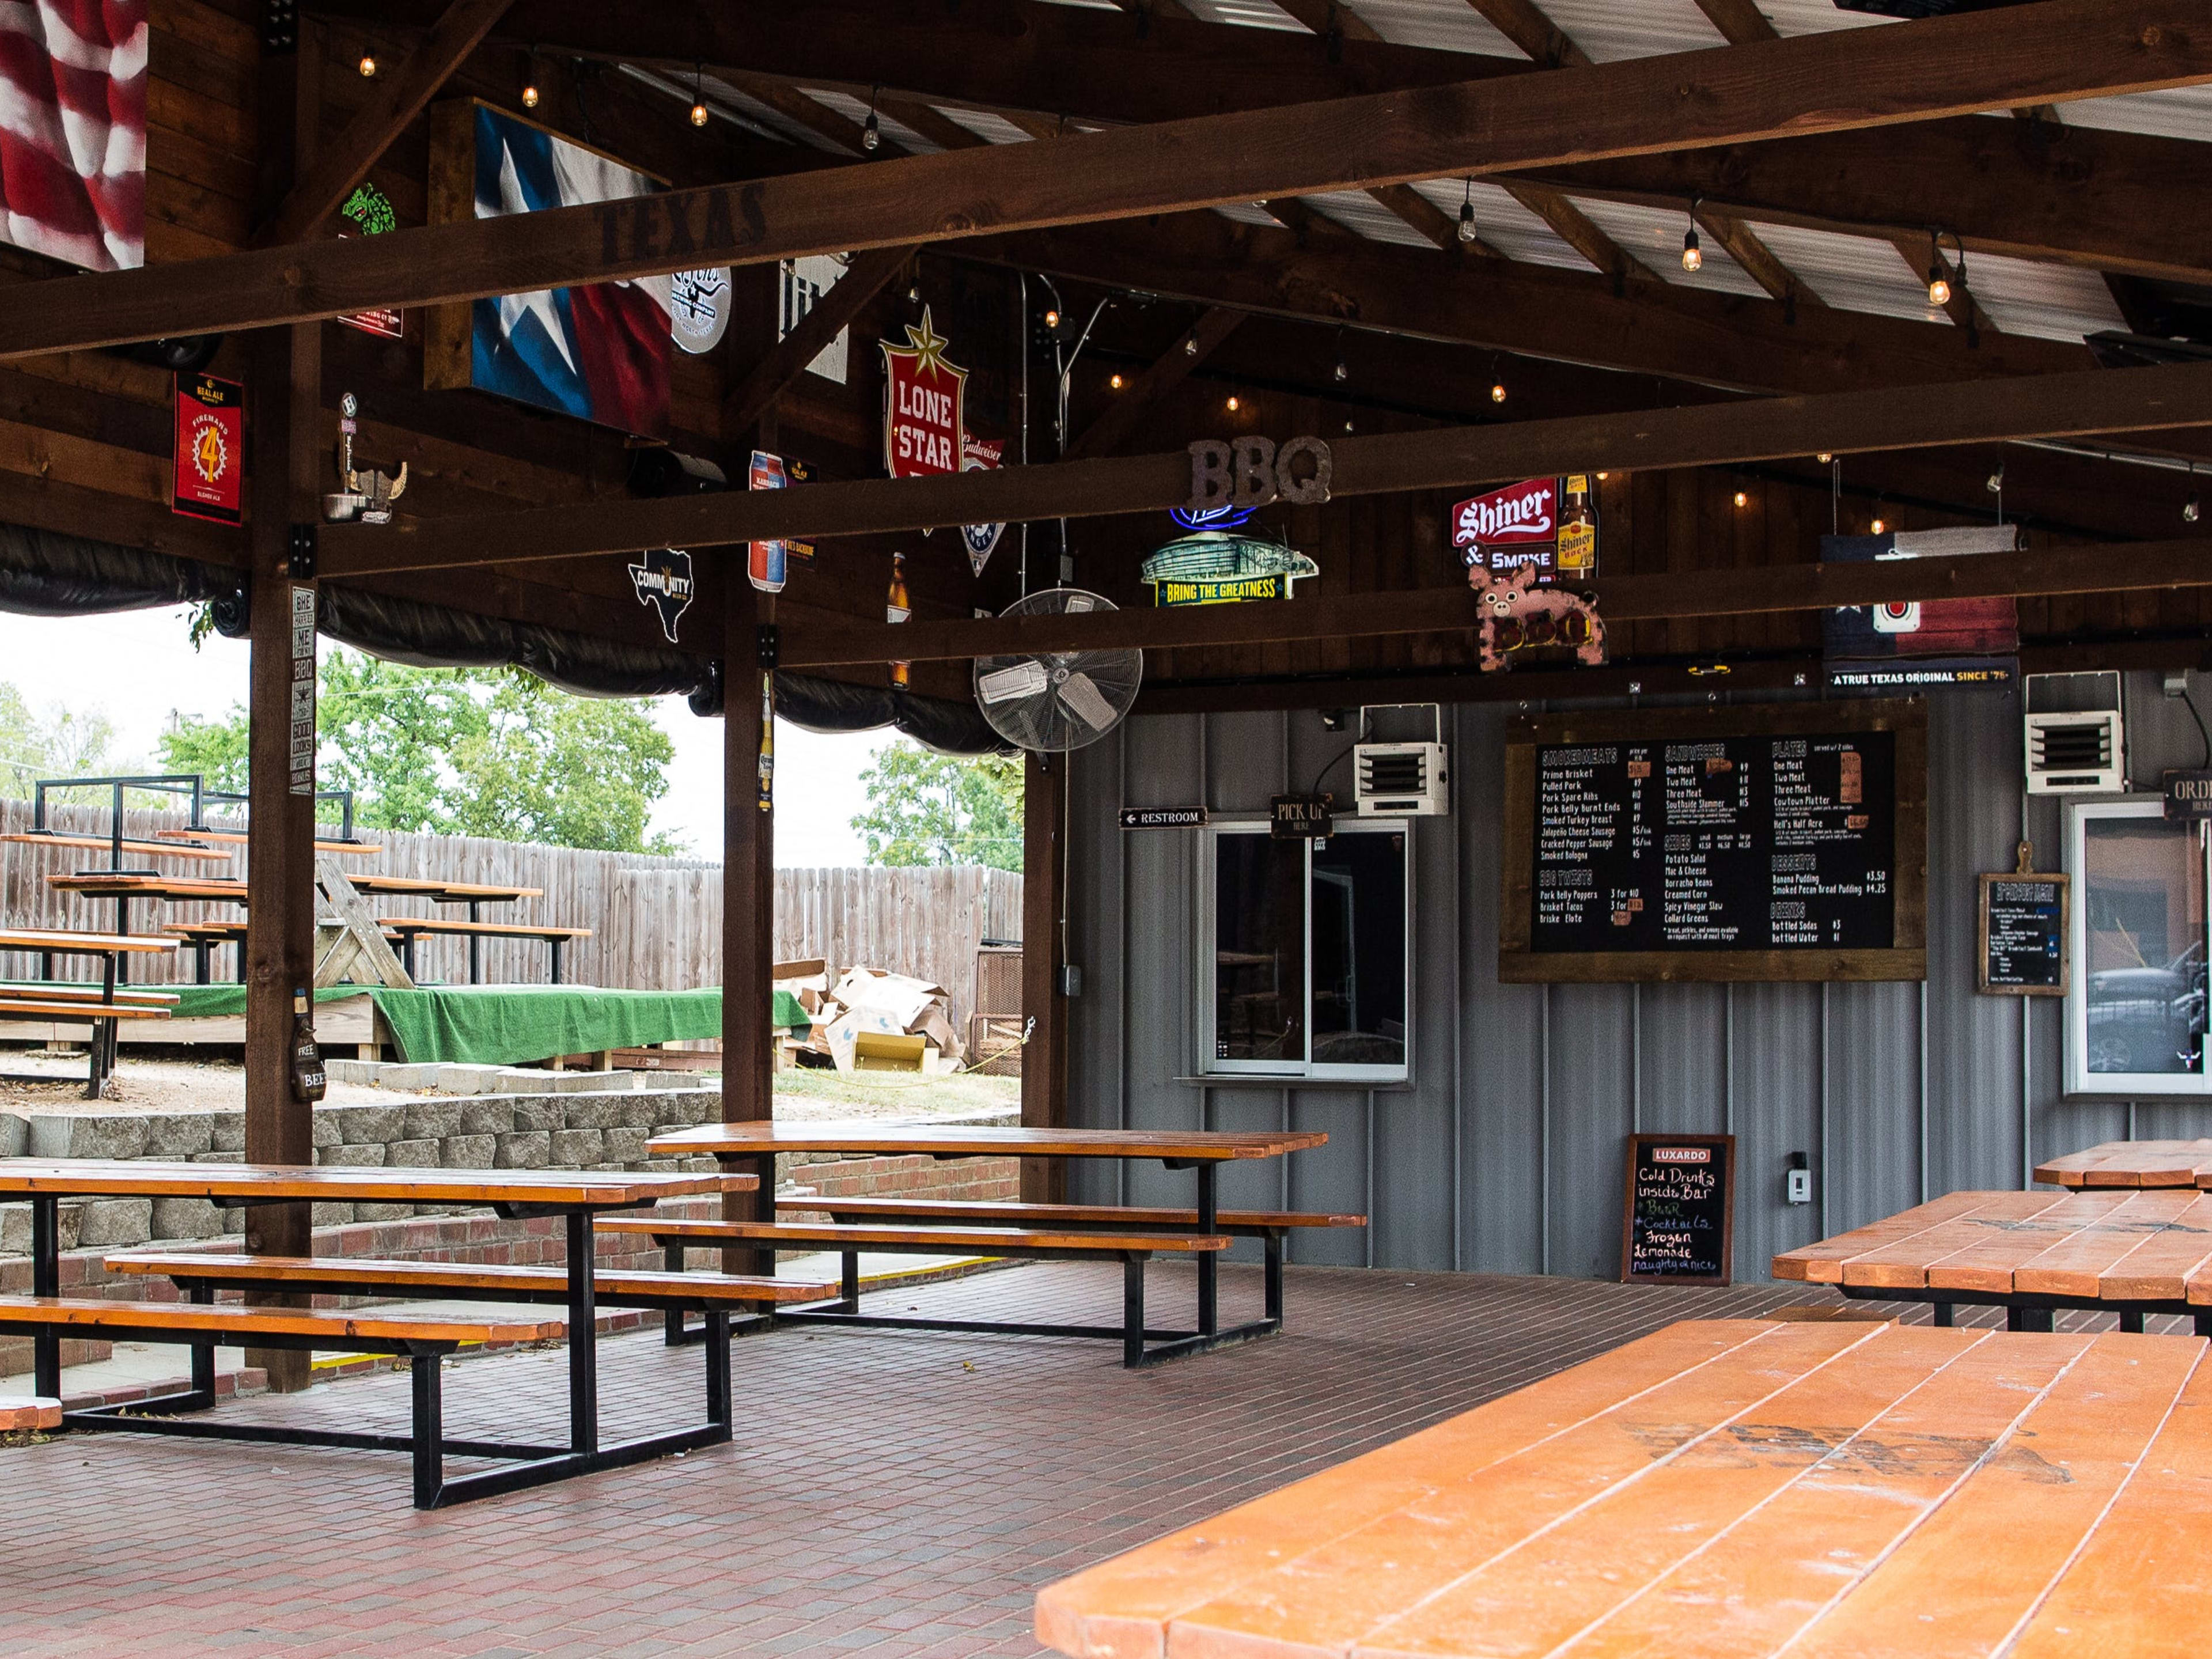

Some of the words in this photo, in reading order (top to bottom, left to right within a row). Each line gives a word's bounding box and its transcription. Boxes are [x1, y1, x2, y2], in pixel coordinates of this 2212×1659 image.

[593, 183, 766, 266] TEXAS
[899, 380, 951, 428] LONE
[899, 424, 952, 471] STAR
[963, 434, 1001, 461] Budweiser
[201, 426, 218, 483] 4
[1187, 435, 1332, 509] BBQ
[1456, 489, 1551, 543] Shiner
[1559, 533, 1592, 552] Shiner
[1466, 545, 1483, 565] &
[638, 570, 690, 597] COMMUNITY
[1167, 584, 1196, 603] BRING
[1199, 583, 1217, 599] THE
[1219, 578, 1275, 598] GREATNESS
[297, 594, 311, 611] SHE
[1493, 608, 1592, 652] BBQ
[298, 630, 310, 647] ME
[295, 659, 312, 680] BBQ
[1834, 675, 1842, 685] A
[1842, 675, 1869, 685] TRUE
[1870, 674, 1904, 684] TEXAS
[1906, 672, 1955, 683] ORIGINAL
[1957, 671, 1987, 681] SINCE
[1666, 766, 1677, 775] One
[1679, 765, 1694, 774] Meat
[1740, 763, 1748, 772] $9
[1774, 761, 1785, 770] One
[1786, 760, 1802, 770] Meat
[1543, 770, 1563, 779] Prime
[1566, 768, 1593, 778] Brisket
[1775, 772, 1787, 782] Two
[1789, 772, 1805, 781] Meat
[1543, 782, 1562, 791] Pulled
[1565, 781, 1582, 790] Pork
[1634, 779, 1641, 787] $9
[1666, 777, 1679, 786] Two
[1680, 777, 1696, 786] Meat
[1666, 789, 1684, 798] Three
[1686, 788, 1702, 797] Meat
[1774, 785, 1793, 794] Three
[1795, 783, 1811, 793] Meat
[1543, 793, 1559, 802] Pork
[1562, 793, 1581, 804] Spare
[1584, 791, 1599, 801] Ribs
[1774, 797, 1803, 806] Cowtown
[1805, 796, 1830, 805] Platter
[1543, 805, 1559, 814] Pork
[1561, 804, 1579, 815] Belly
[1581, 804, 1601, 812] Burnt
[1604, 802, 1620, 811] Ends
[1666, 800, 1696, 809] Southside
[1699, 800, 1725, 808] Slammer
[1141, 812, 1198, 824] RESTROOM
[1278, 804, 1303, 820] PICK
[1543, 816, 1565, 825] Smoked
[1567, 816, 1589, 826] Turkey
[1591, 815, 1612, 824] Breast
[1774, 819, 1791, 829] Hell's
[1793, 819, 1806, 828] Half
[1808, 819, 1823, 828] Acre
[1569, 827, 1589, 836] Cheese
[1591, 827, 1615, 837] Sausage
[1541, 839, 1565, 849] Cracked
[1566, 839, 1586, 850] Pepper
[1589, 839, 1612, 850] Sausage
[1541, 851, 1563, 860] Smoked
[1565, 851, 1588, 862] Bologna
[1633, 850, 1640, 858] $5
[1666, 854, 1688, 864] Potato
[1691, 854, 1706, 863] Salad
[1665, 866, 1676, 876] Mac
[1678, 866, 1683, 876] &
[1684, 866, 1706, 875] Cheese
[1665, 878, 1693, 888] Borracho
[1695, 877, 1713, 887] Beans
[1772, 874, 1793, 884] Banana
[1796, 874, 1819, 885] Pudding
[1866, 871, 1885, 881] $3.50
[1540, 891, 1554, 900] Pork
[1556, 891, 1571, 901] Belly
[1573, 889, 1597, 901] Poppers
[1611, 888, 1615, 898] 3
[1617, 889, 1626, 898] for
[1665, 890, 1691, 899] Creamed
[1692, 889, 1707, 899] Corn
[1772, 885, 1797, 895] Smoked
[1798, 885, 1816, 893] Pecan
[1819, 884, 1836, 893] Bread
[1839, 884, 1862, 896] Pudding
[1866, 883, 1886, 893] $4.25
[1540, 902, 1563, 911] Brisket
[1567, 902, 1583, 911] Tacos
[1616, 901, 1626, 910] for
[1665, 902, 1681, 914] Spicy
[1684, 902, 1707, 912] Vinegar
[1709, 901, 1723, 910] Slaw
[1565, 914, 1582, 923] Elote
[1664, 914, 1685, 923] Collard
[1687, 914, 1709, 923] Greens
[1772, 921, 1797, 930] Bottled
[1799, 921, 1817, 930] Sodas
[1833, 919, 1840, 929] $3
[1772, 933, 1797, 943] Bottled
[1799, 933, 1819, 942] Water
[298, 1044, 314, 1056] FREE
[1656, 1150, 1706, 1160] LUXARDO
[1639, 1168, 1665, 1181] Cold
[1669, 1167, 1715, 1187] Drinks
[1639, 1184, 1679, 1198] inside
[1680, 1183, 1711, 1200] Bar
[1643, 1214, 1713, 1229] Cocktails
[1646, 1230, 1692, 1248] Frozen
[1634, 1243, 1692, 1258] Lemonade
[1633, 1259, 1677, 1276] naughty
[1691, 1259, 1716, 1270] nice
